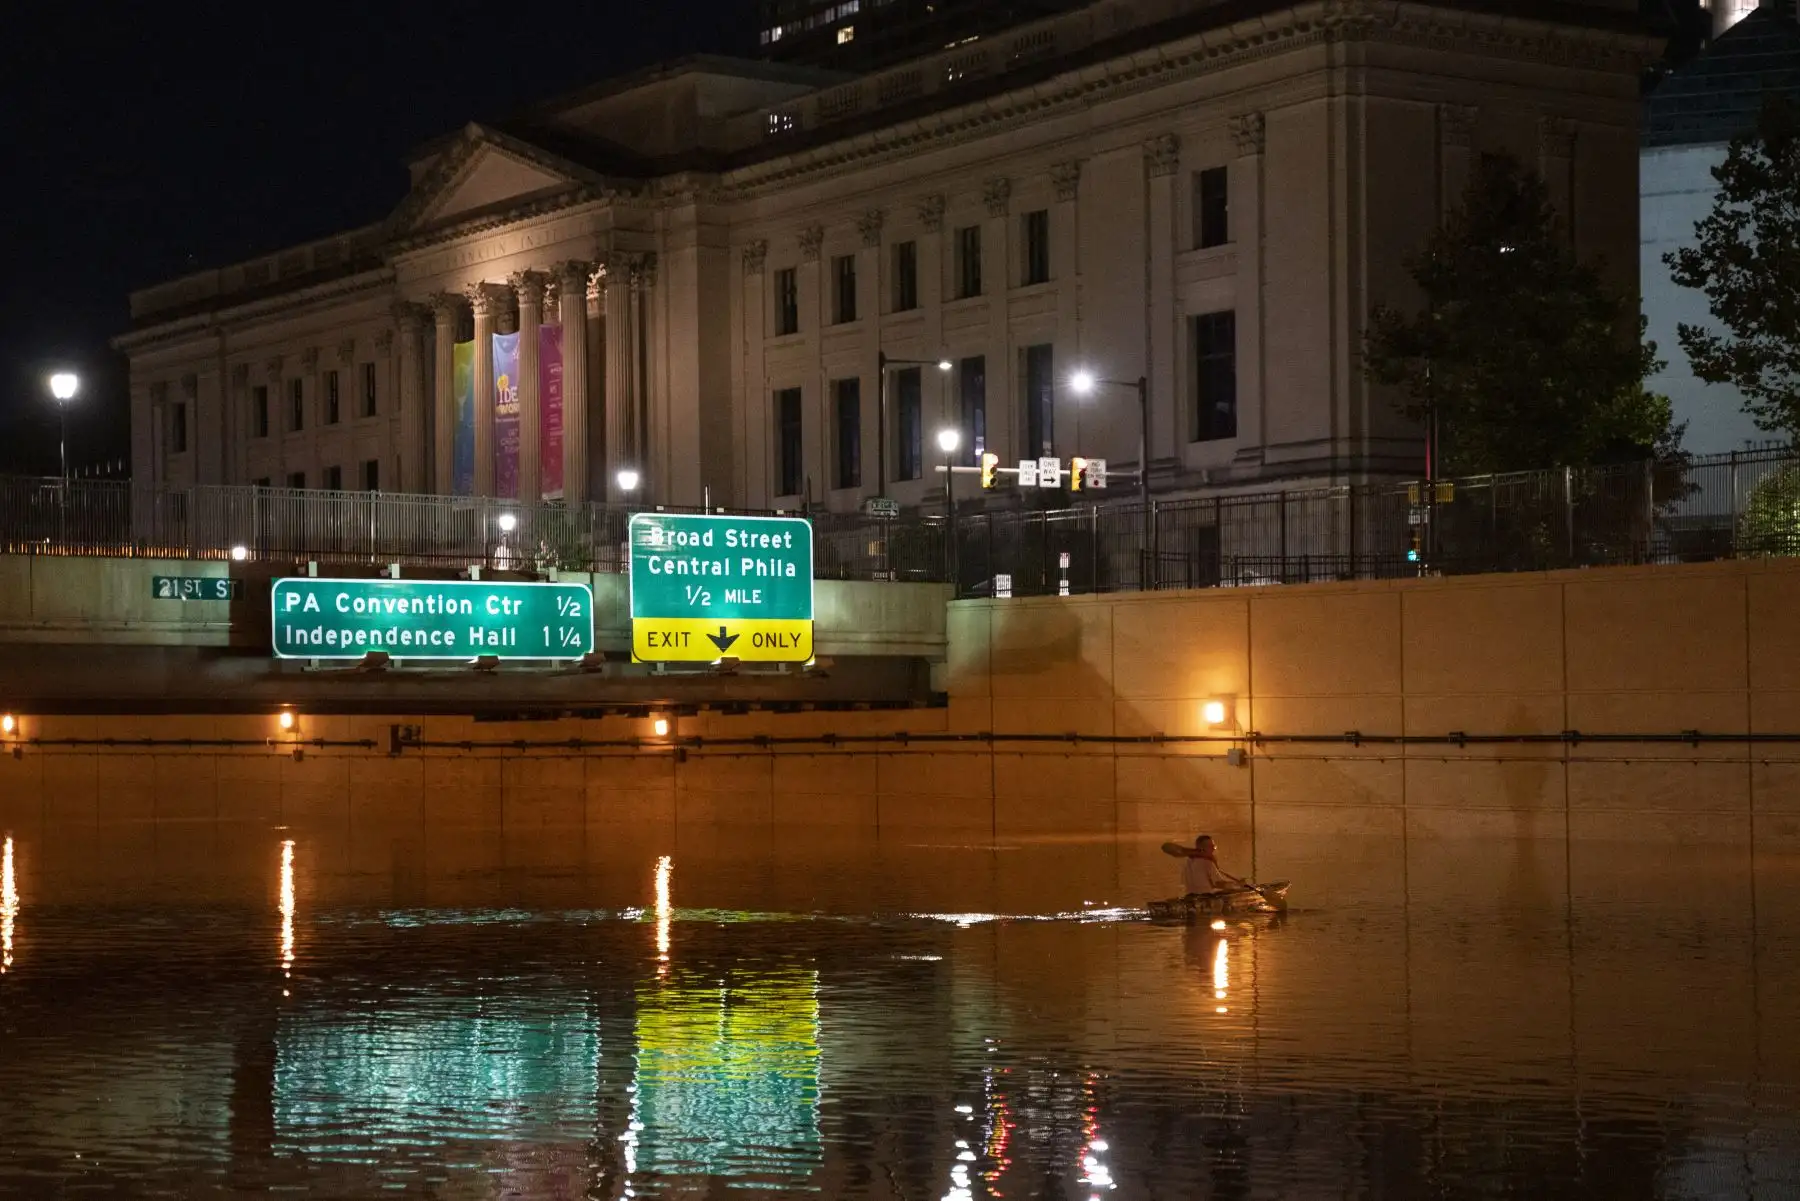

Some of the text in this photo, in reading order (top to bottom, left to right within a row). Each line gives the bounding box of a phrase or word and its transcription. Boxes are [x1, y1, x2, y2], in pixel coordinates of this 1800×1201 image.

[651, 527, 793, 549] Broad Street
[648, 556, 797, 577] Central Phila
[284, 591, 321, 613] PA
[335, 592, 473, 614] Convention
[485, 592, 524, 615] Ctr
[725, 589, 762, 604] MILE
[284, 624, 456, 649] Independence
[469, 625, 517, 647] Hall
[647, 631, 802, 649] EXIT ONLY
